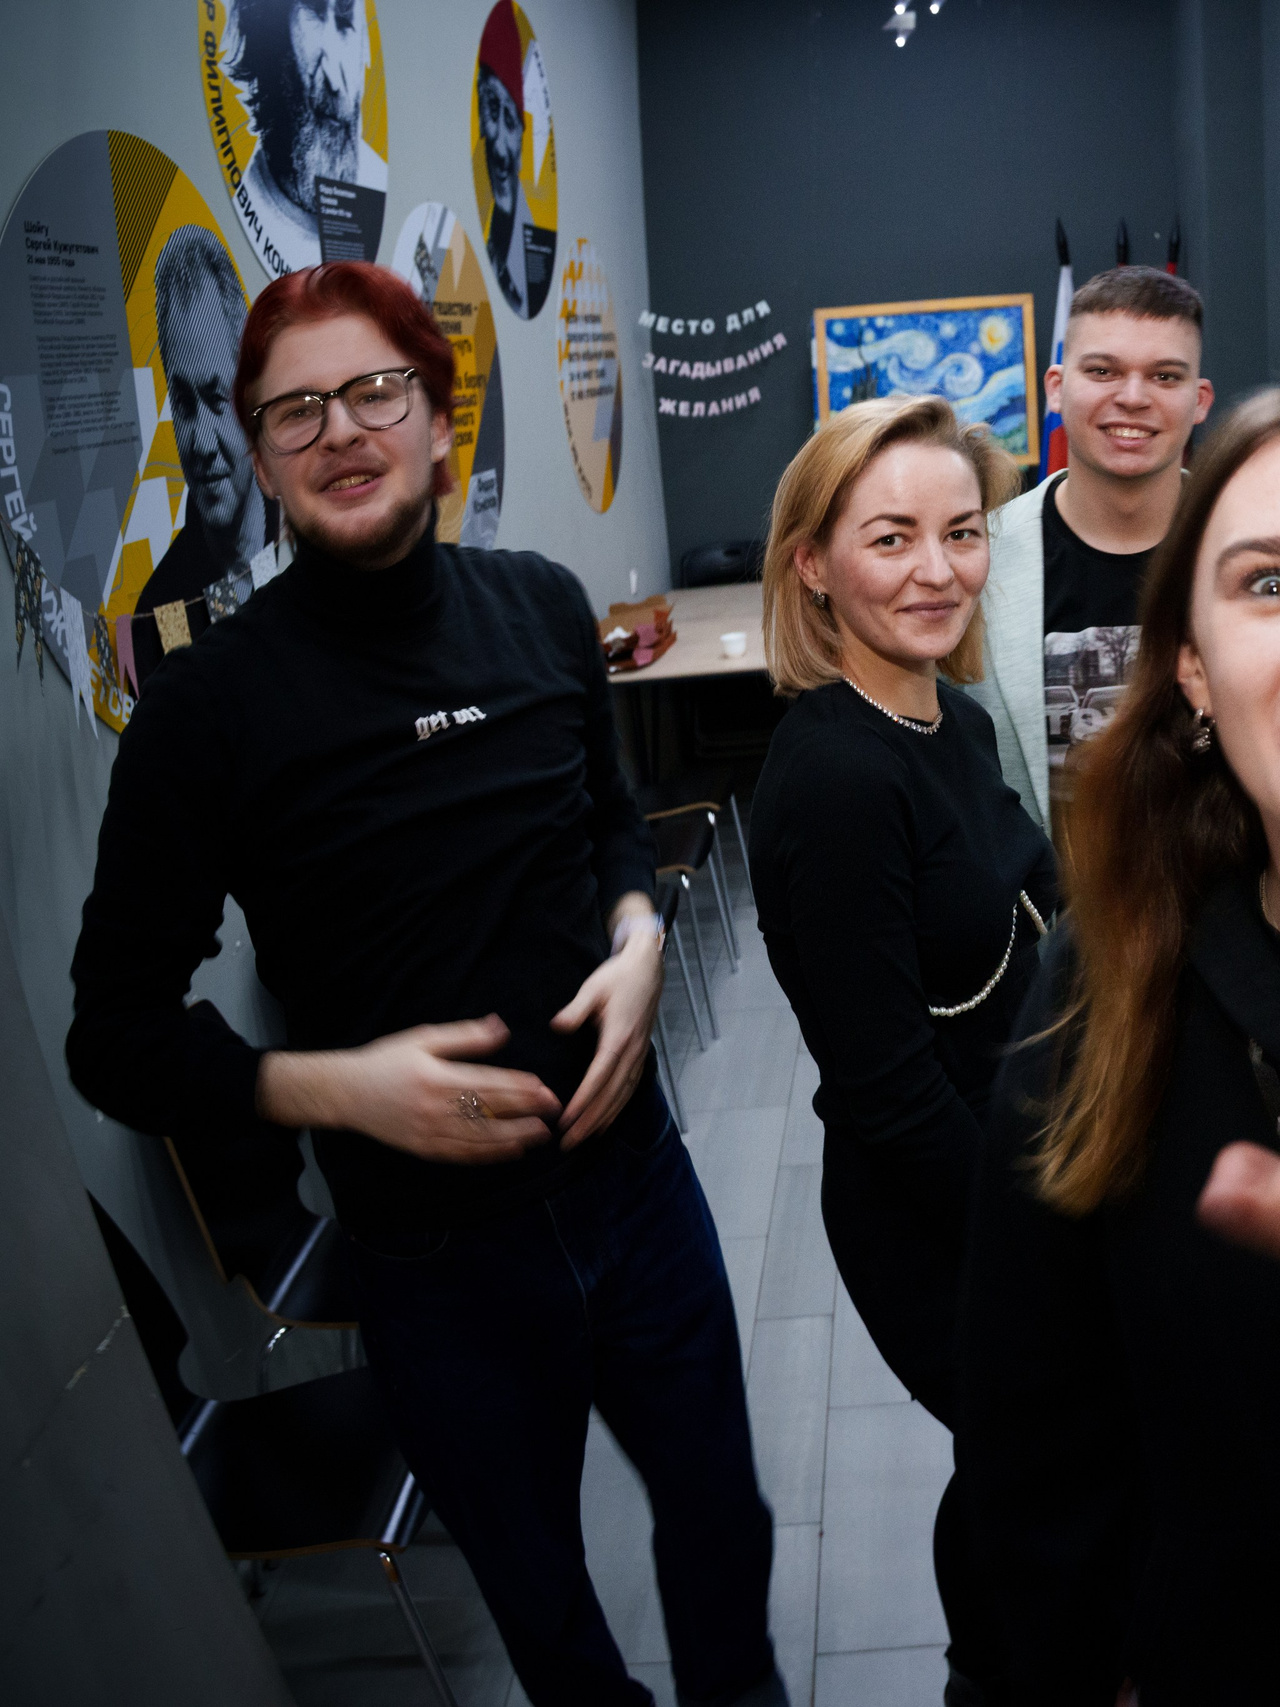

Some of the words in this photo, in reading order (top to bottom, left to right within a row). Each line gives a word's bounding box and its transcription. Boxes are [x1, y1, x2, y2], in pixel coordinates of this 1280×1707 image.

[203, 30, 263, 243] ФИЛИППОВИЧ
[262, 236, 292, 277] КОН
[24, 220, 49, 237] Шойгу
[25, 237, 51, 251] Сергей
[637, 308, 716, 335] МЕСТО
[726, 298, 772, 335] ДЛЯ
[641, 332, 788, 381] ЗАГАДЫВАНИЯ
[659, 385, 762, 417] ЖЕЛАНИЯ
[0, 382, 37, 542] СЕРГЕЙ
[415, 711, 451, 741] get
